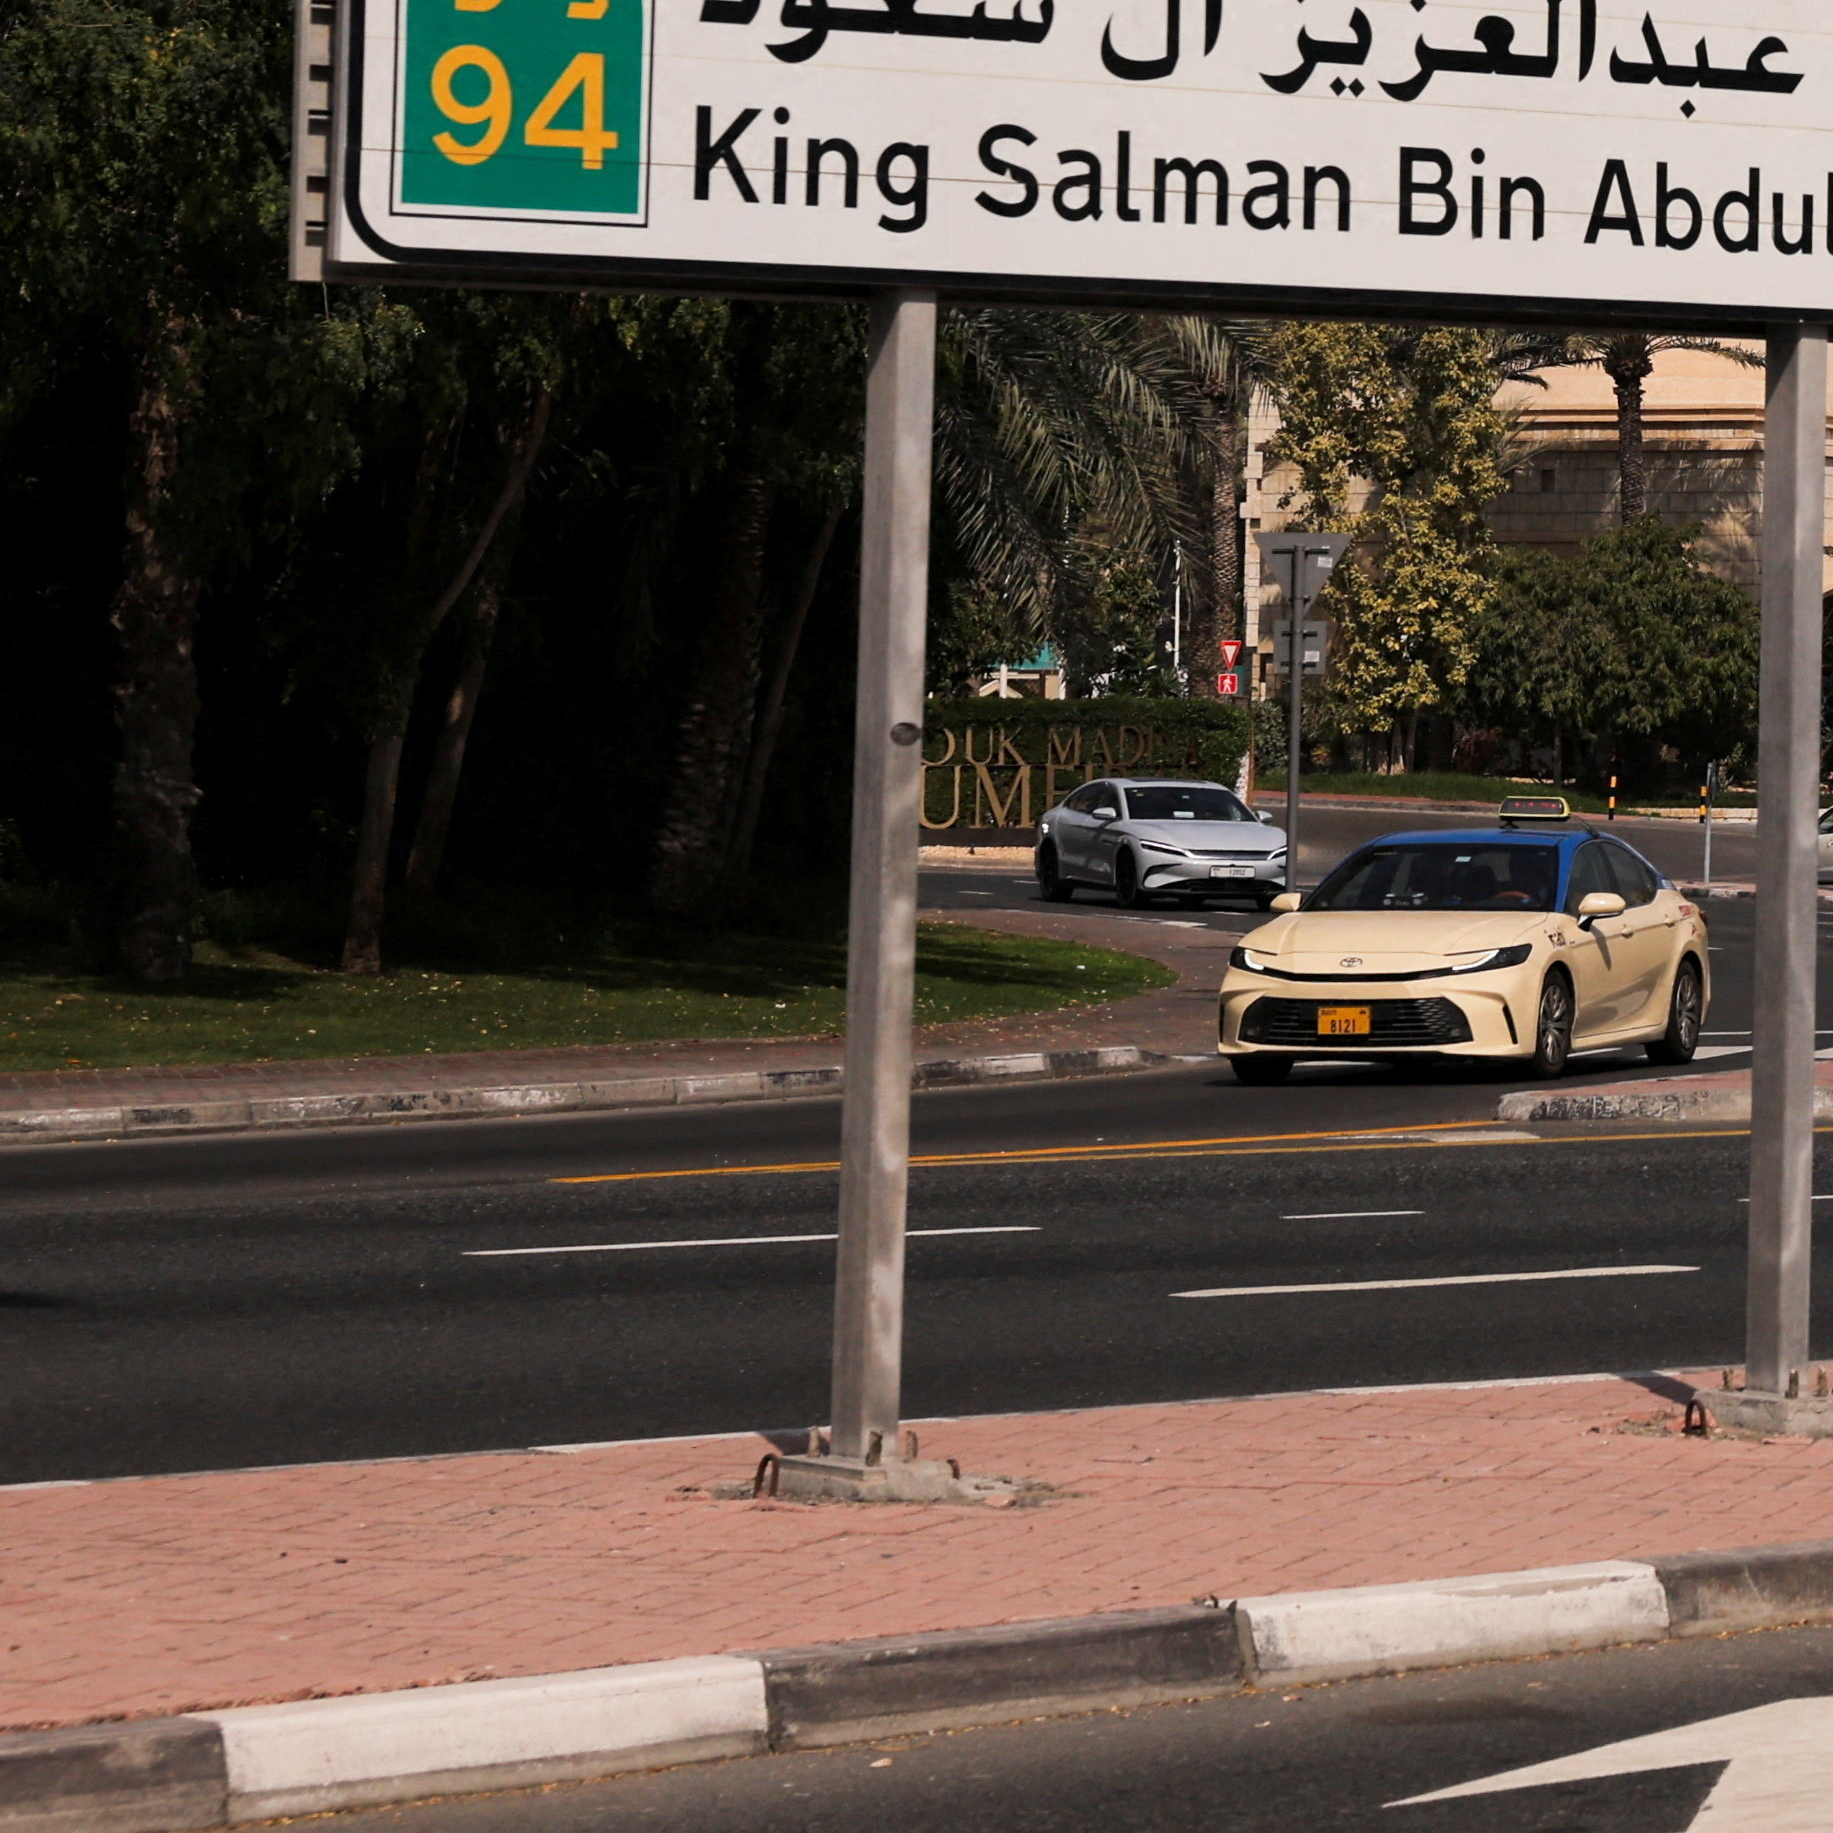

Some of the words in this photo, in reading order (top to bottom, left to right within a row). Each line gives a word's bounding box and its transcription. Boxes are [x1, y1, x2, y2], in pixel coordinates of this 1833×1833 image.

[431, 44, 618, 169] 94
[694, 106, 929, 233] King
[975, 124, 1350, 231] Salman
[1399, 147, 1544, 240] Bin
[922, 726, 1025, 765] OUK
[1330, 1019, 1355, 1033] 8121
